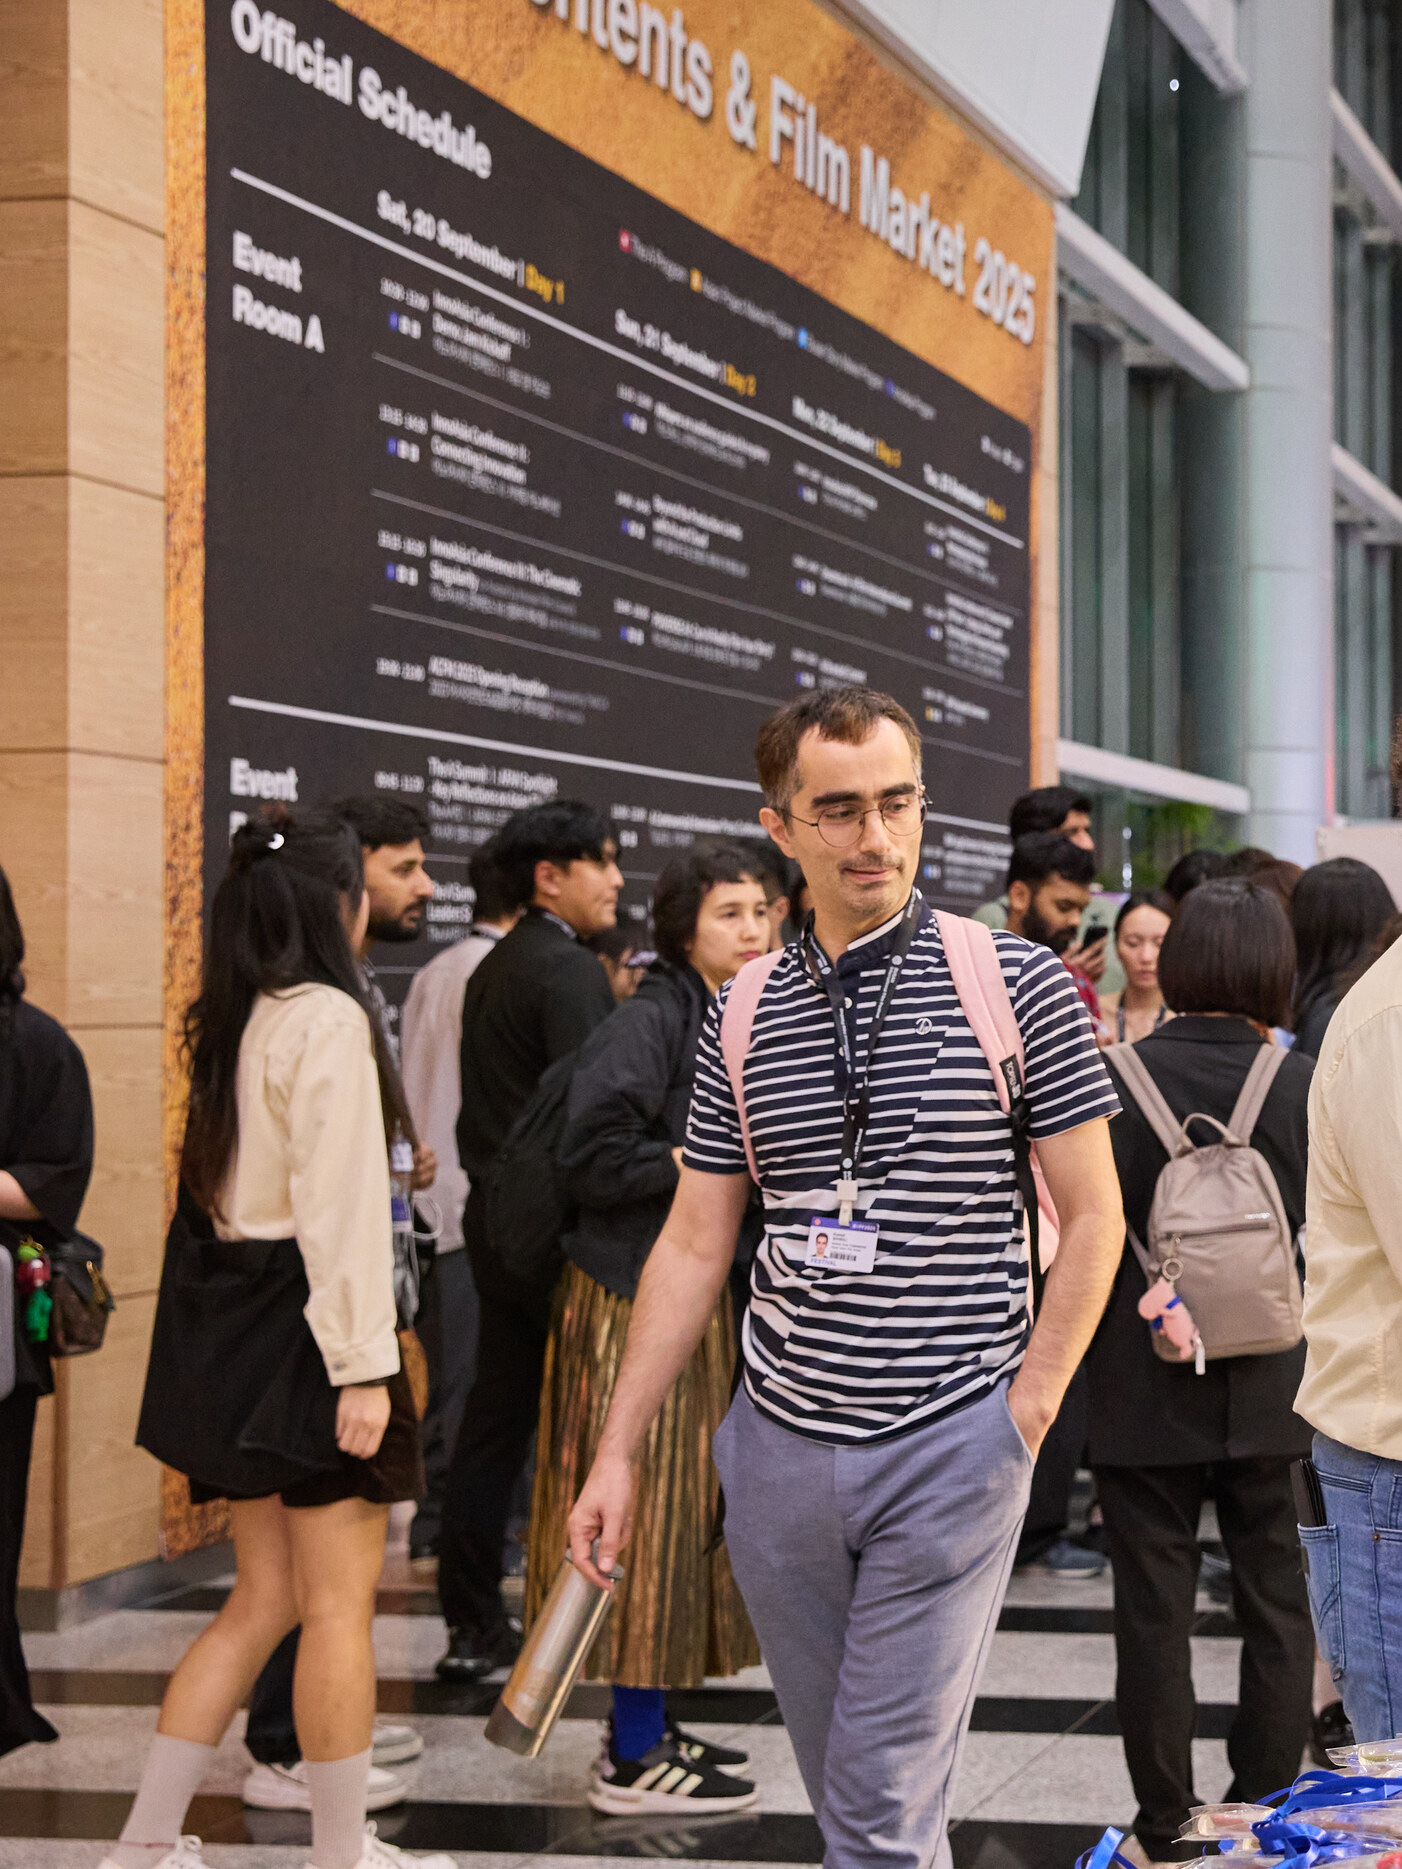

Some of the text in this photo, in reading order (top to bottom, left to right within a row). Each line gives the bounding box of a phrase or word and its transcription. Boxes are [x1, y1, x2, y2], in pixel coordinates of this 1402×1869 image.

[231, 0, 492, 179] Official Schedule
[726, 49, 756, 150] &
[770, 75, 850, 213] Film
[860, 145, 966, 295] Market
[973, 237, 1037, 345] 2025
[233, 230, 302, 292] Event
[437, 218, 516, 280] September
[525, 263, 554, 303] Day
[556, 280, 565, 304] 1
[233, 284, 325, 353] Room A
[230, 757, 299, 802] Event
